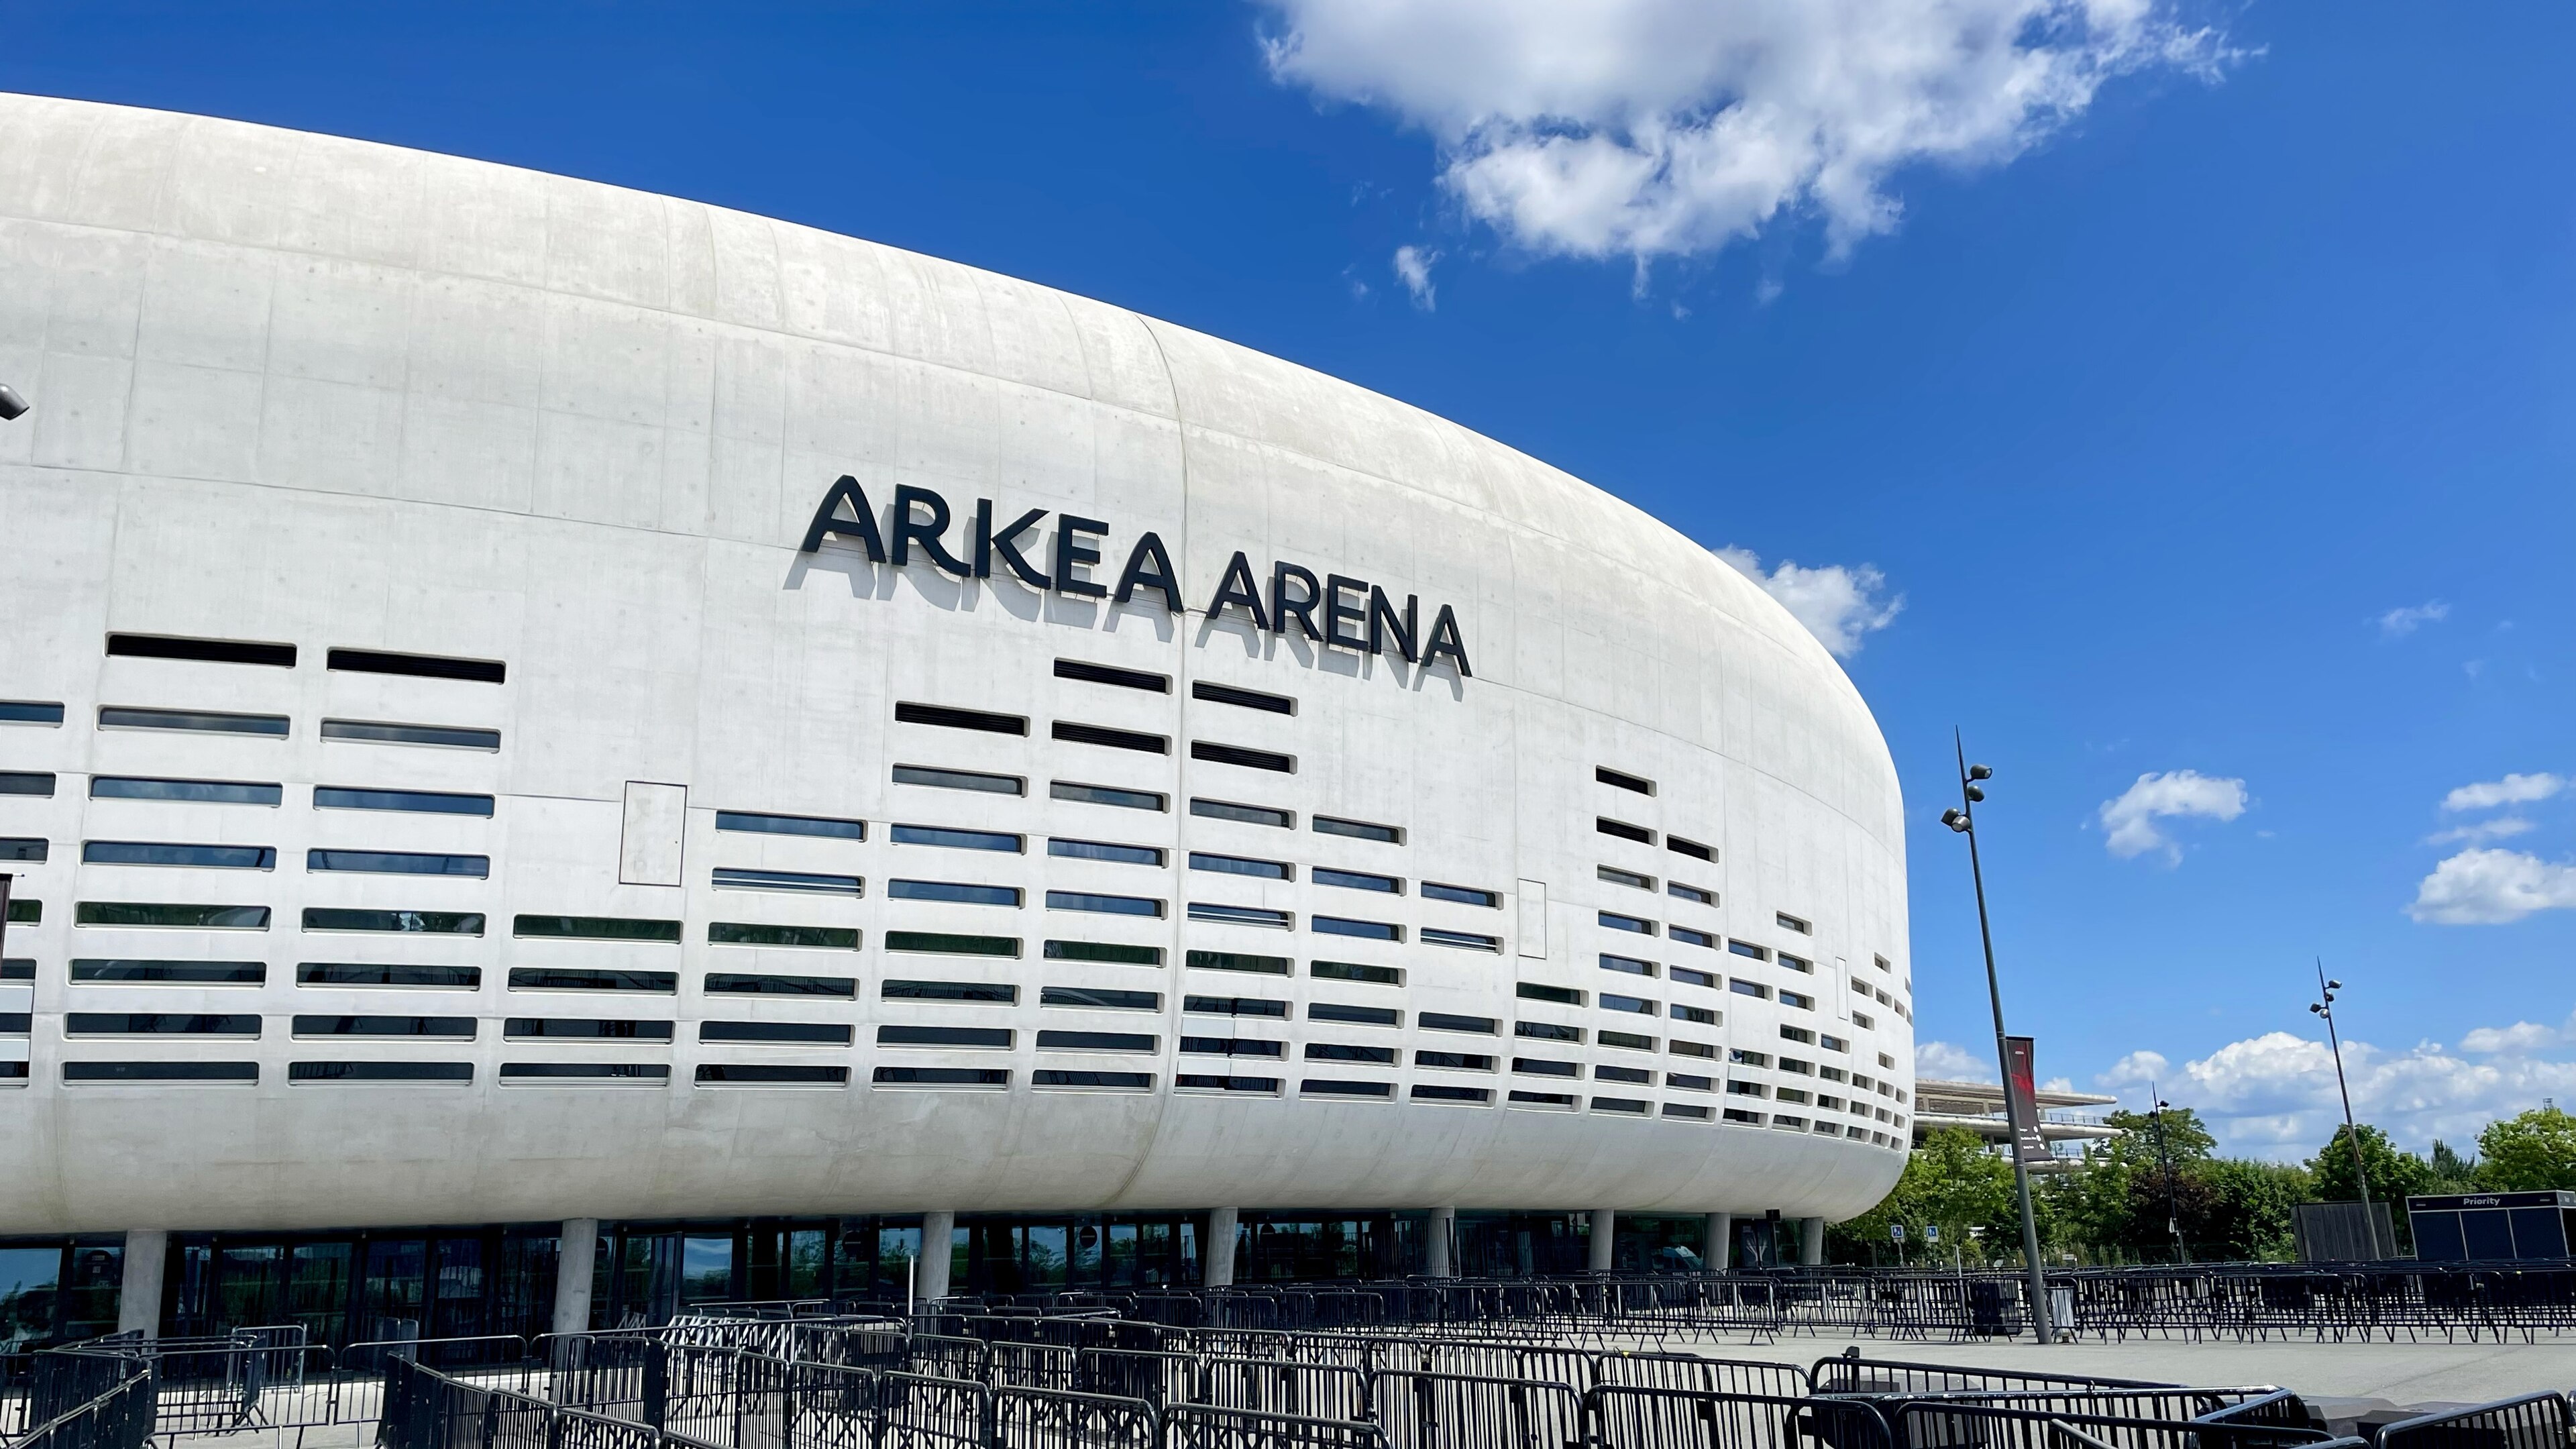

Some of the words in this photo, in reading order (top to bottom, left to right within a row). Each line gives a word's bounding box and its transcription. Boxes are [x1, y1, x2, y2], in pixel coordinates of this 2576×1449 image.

[804, 474, 1185, 616] ARKEA
[1203, 549, 1473, 678] ARENA
[2463, 1197, 2500, 1206] Priority
